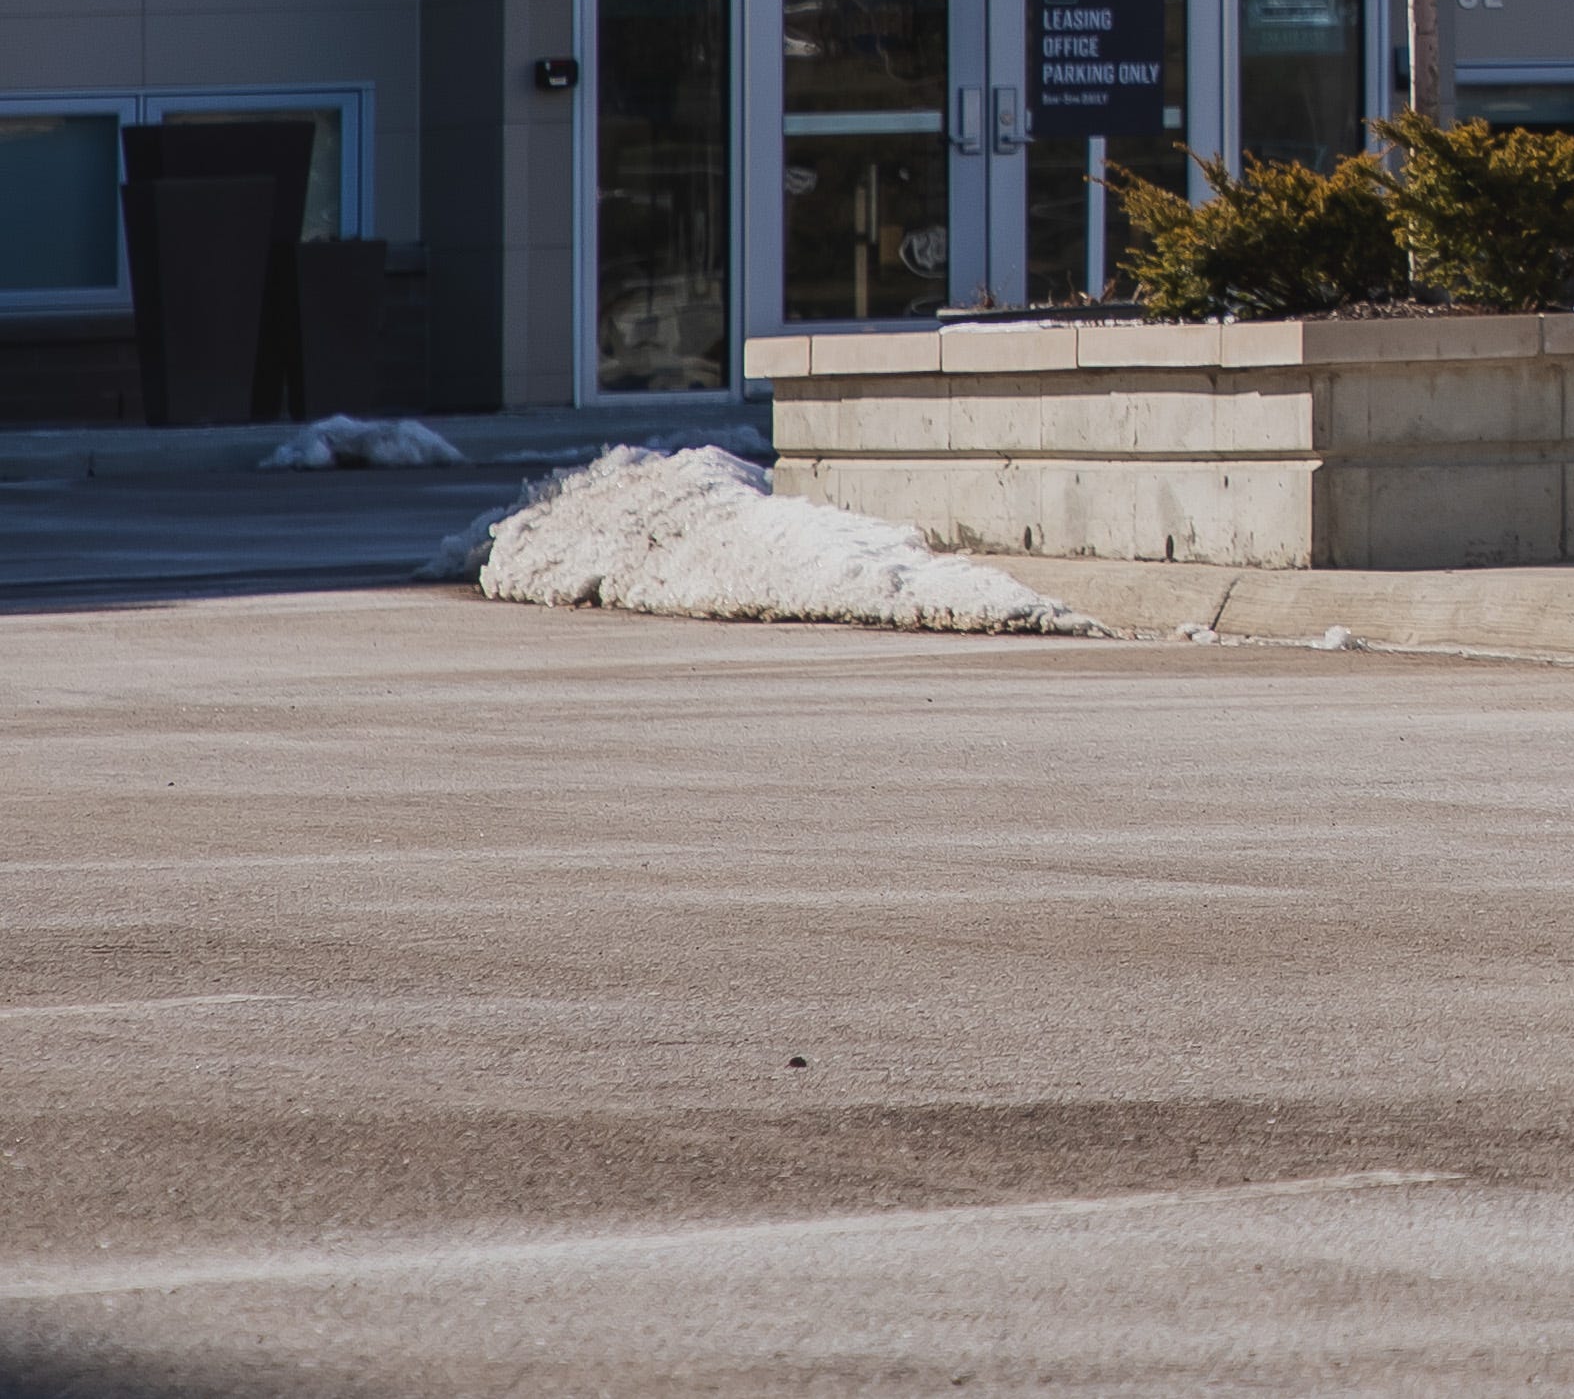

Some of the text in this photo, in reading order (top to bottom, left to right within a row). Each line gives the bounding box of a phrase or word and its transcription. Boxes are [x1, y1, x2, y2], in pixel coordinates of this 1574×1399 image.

[1042, 8, 1112, 31] LEASING
[1042, 35, 1099, 58] OFFICE
[1042, 62, 1160, 85] PARKING ONLY
